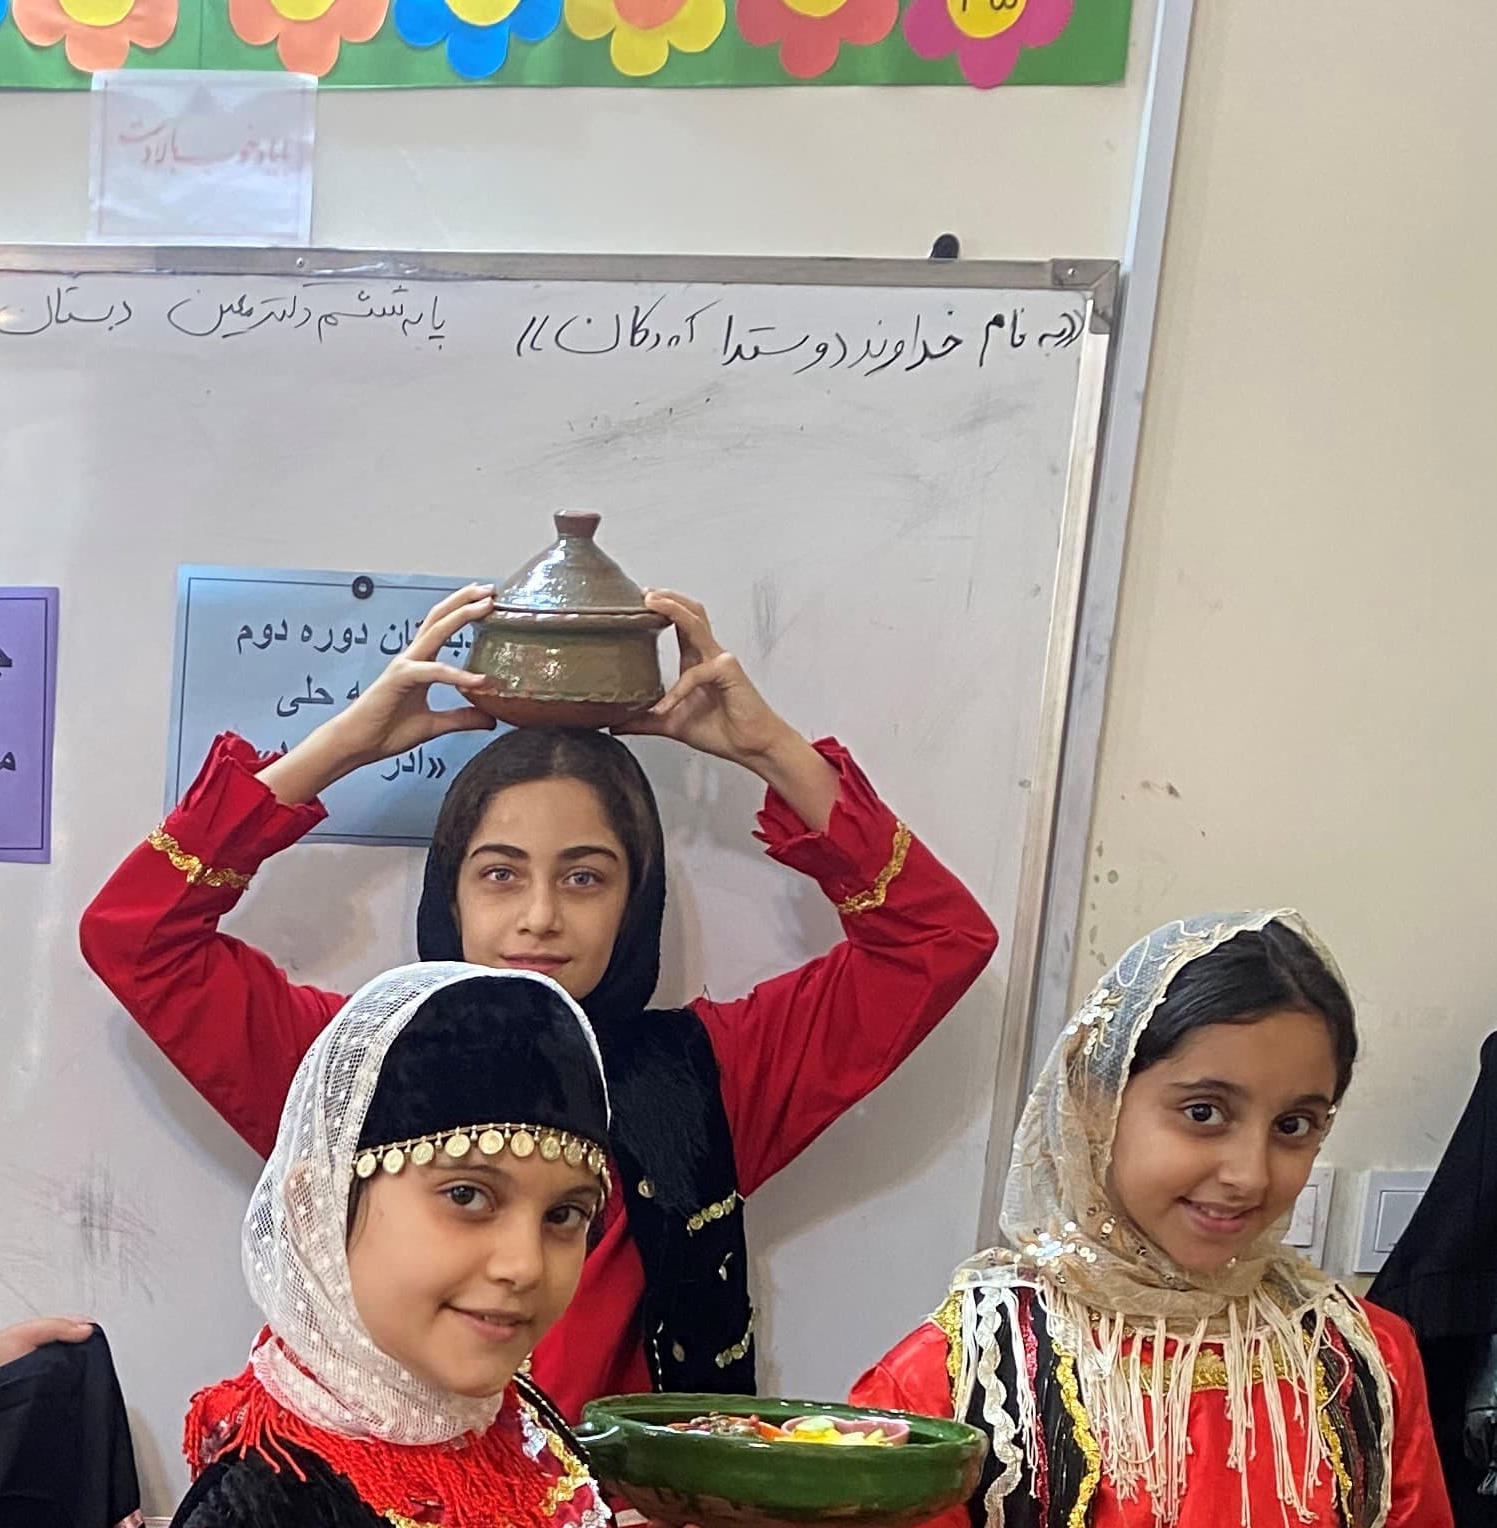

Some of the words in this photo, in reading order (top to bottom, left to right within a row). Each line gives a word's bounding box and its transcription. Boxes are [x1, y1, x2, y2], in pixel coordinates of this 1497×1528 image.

[979, 308, 1028, 368] نام
[237, 618, 289, 654] دوم
[300, 618, 368, 654] دوره
[276, 673, 335, 718] حلی
